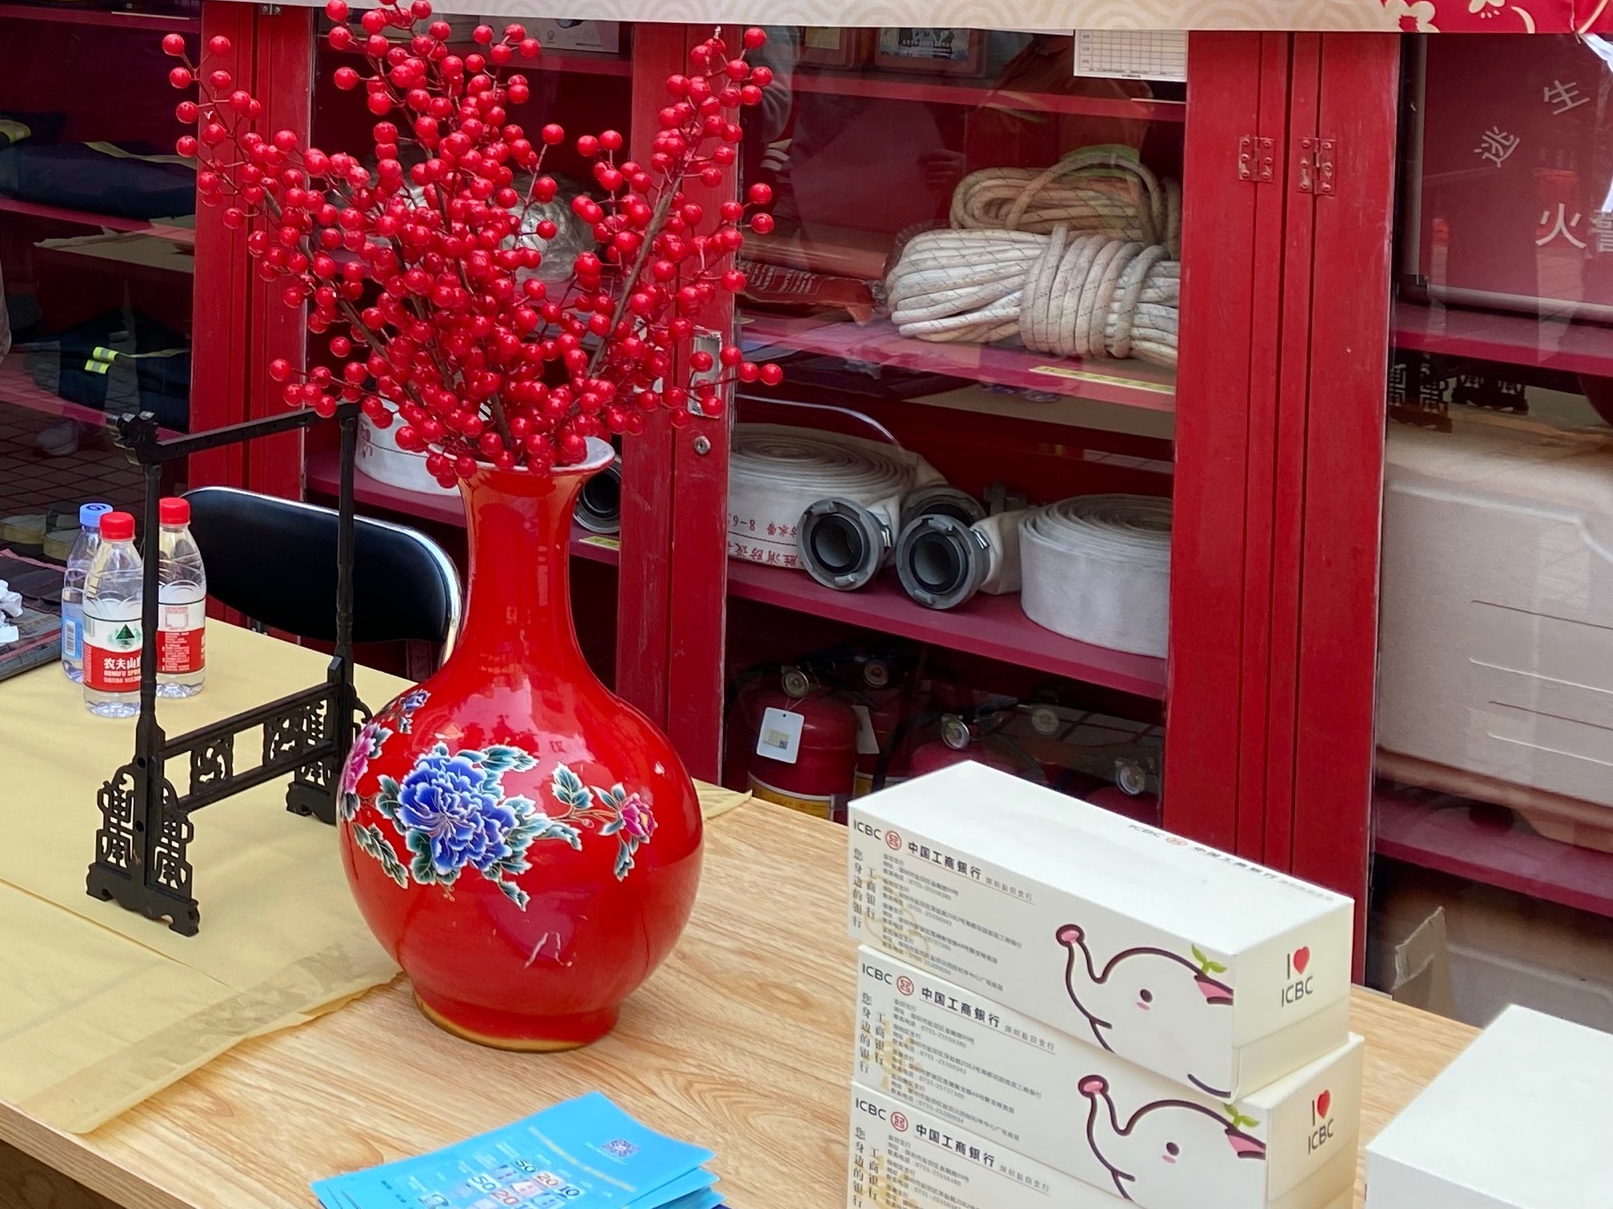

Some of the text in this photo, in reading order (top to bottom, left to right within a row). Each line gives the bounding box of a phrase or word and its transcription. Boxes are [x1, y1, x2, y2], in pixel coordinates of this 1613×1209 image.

[853, 819, 882, 841] ICBC
[908, 841, 982, 881] 中国工商银行
[853, 847, 864, 929] 您身边的银行
[862, 963, 893, 986] ICBC
[921, 987, 1000, 1029] 中国工商银行
[1281, 976, 1313, 1007] ICBC
[859, 992, 872, 1074] 您身边的银行
[855, 1097, 886, 1121] ICBC
[916, 1123, 995, 1168] 中国工商银行
[1308, 1119, 1334, 1154] ICBC
[471, 1176, 496, 1191] 50
[515, 1160, 536, 1174] 50
[537, 1173, 559, 1187] 20
[853, 1126, 866, 1209] 您身边的银行
[491, 1190, 519, 1205] 20
[558, 1185, 580, 1197] 10
